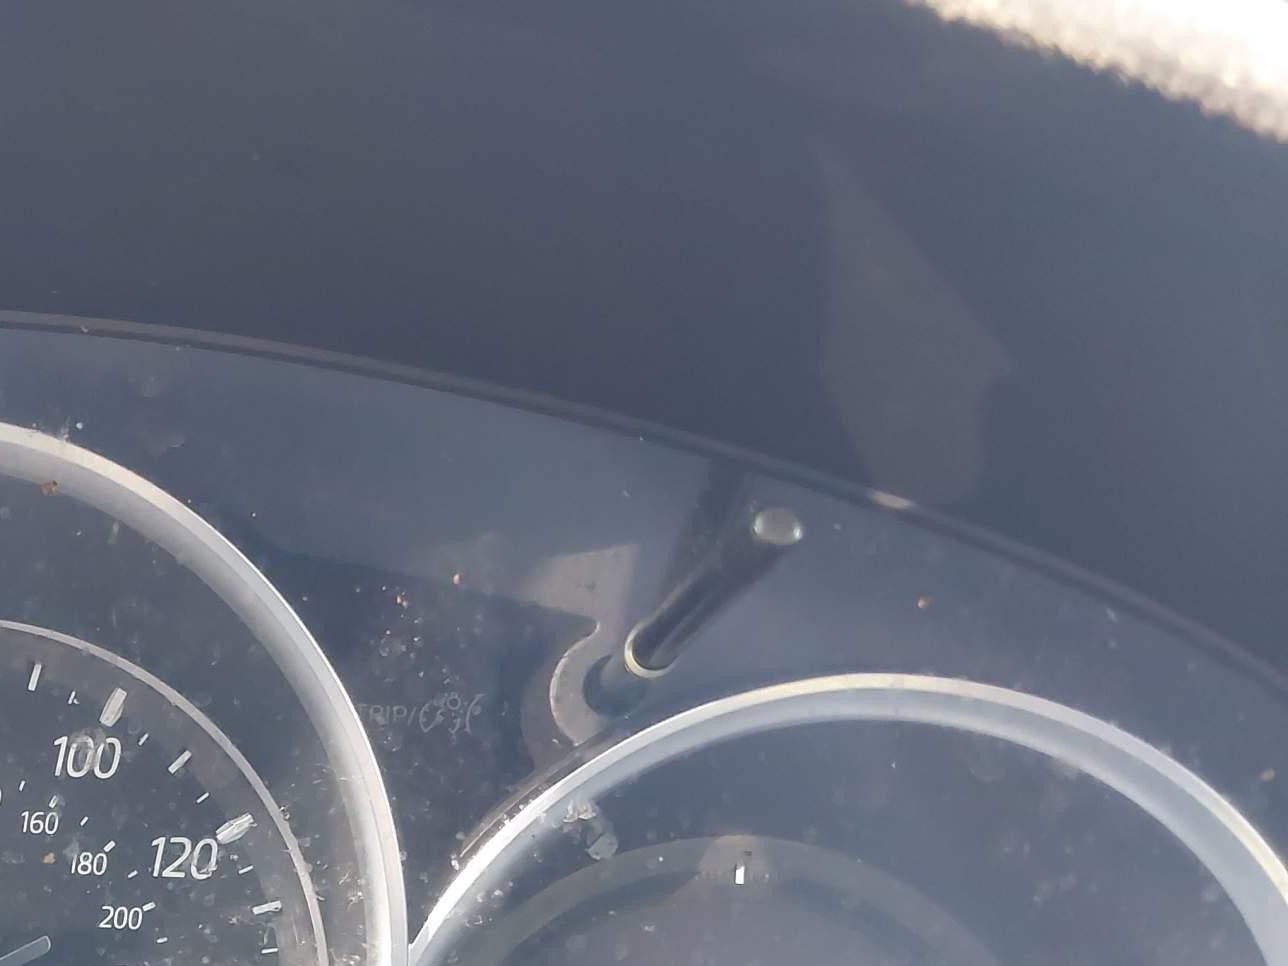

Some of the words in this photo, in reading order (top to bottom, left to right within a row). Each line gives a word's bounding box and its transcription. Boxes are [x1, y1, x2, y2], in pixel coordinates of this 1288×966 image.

[53, 736, 121, 779] 100
[20, 810, 59, 834] 160
[71, 852, 108, 875] 180
[150, 836, 218, 879] 120
[98, 905, 143, 930] 200
